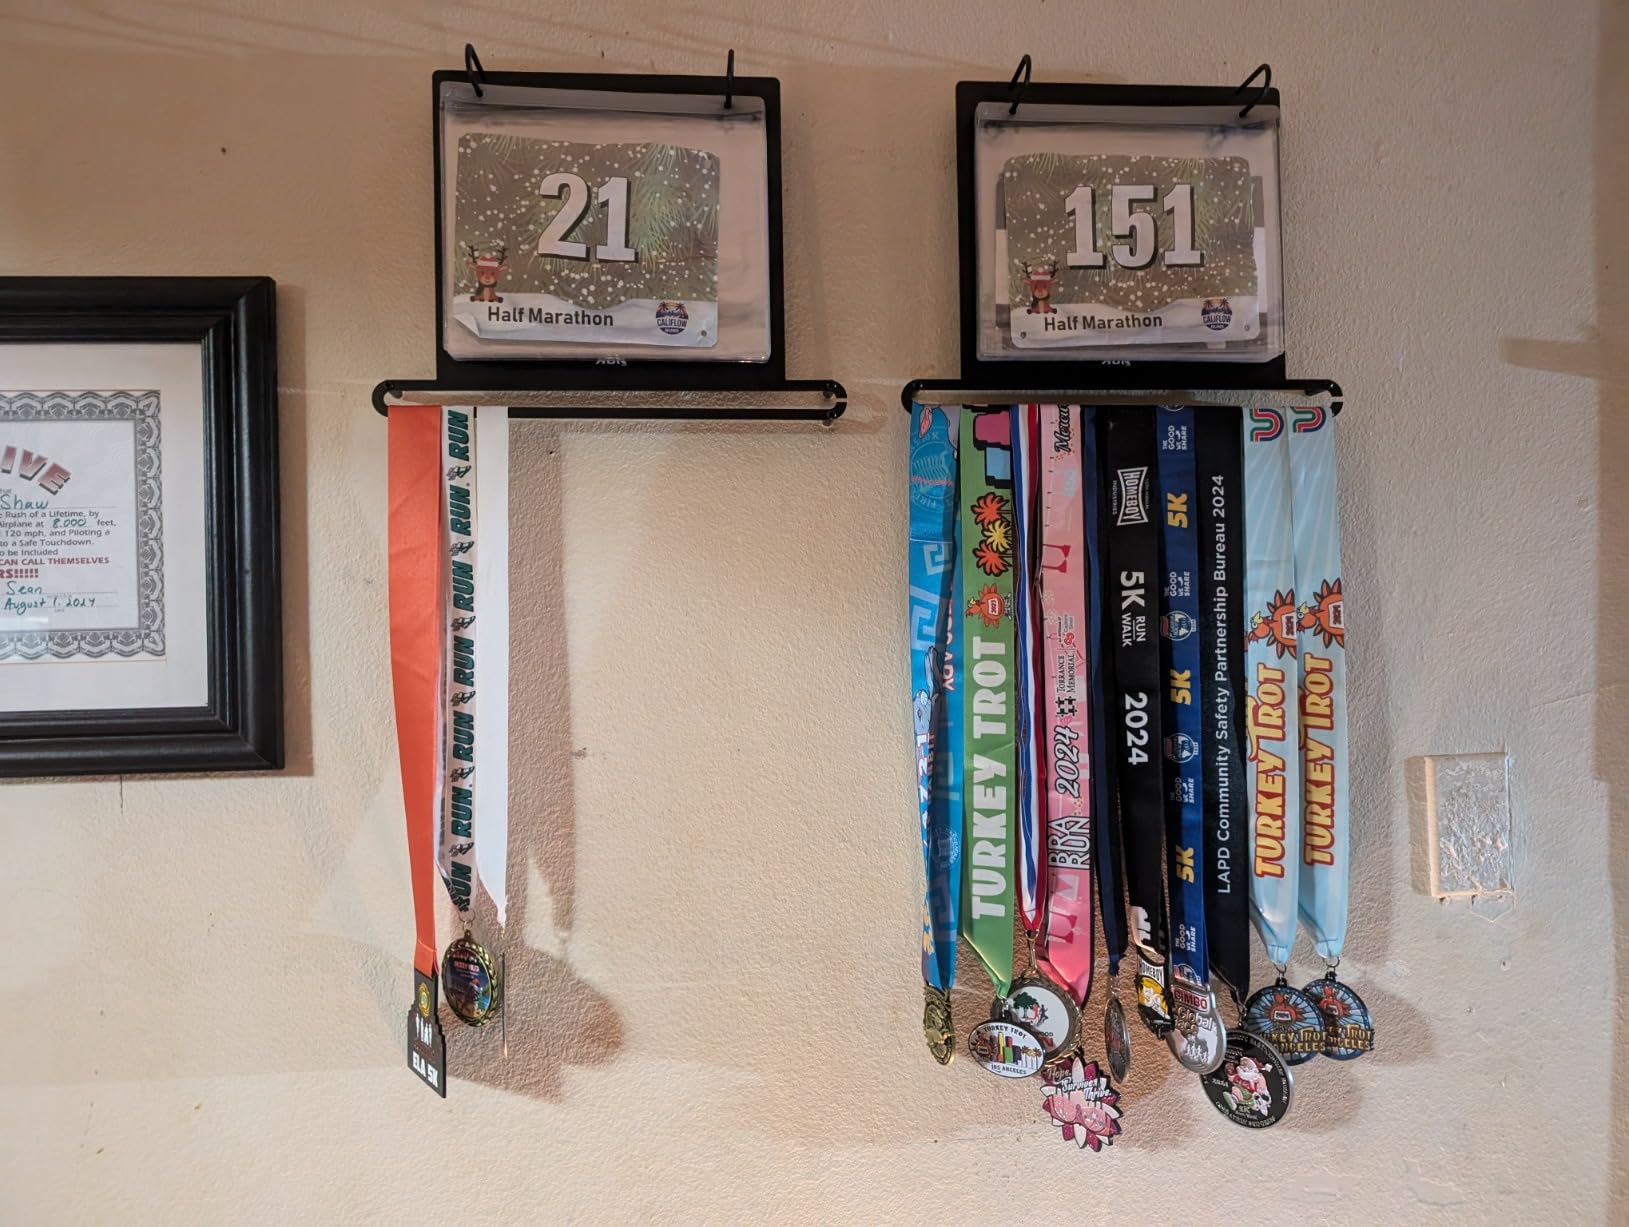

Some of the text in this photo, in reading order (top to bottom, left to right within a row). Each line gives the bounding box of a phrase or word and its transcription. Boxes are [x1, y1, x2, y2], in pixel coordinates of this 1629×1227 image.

[538, 172, 637, 261] 21
[1064, 184, 1203, 268] 151
[488, 306, 614, 326] Half Marathon
[657, 319, 688, 328] CALIFLOW
[1044, 314, 1163, 331] Half Marathon
[1203, 315, 1231, 324] CALIFLOW
[448, 409, 470, 462] RUN
[1167, 425, 1175, 450] GOOD
[0, 493, 48, 510] Shaw
[449, 484, 472, 536] RUN
[1122, 471, 1142, 520] HOMEBOY
[1167, 492, 1188, 529] 5K
[89, 510, 99, 519] by
[40, 538, 95, 547] Touchdown.
[69, 529, 102, 538] Piloting
[21, 558, 45, 566] CALL
[48, 557, 110, 565] THEMSELVES
[6, 580, 42, 596] Sean
[452, 559, 474, 612] RUN
[1120, 571, 1146, 609] 5K
[1169, 571, 1177, 597] GOOD
[1183, 571, 1191, 597] SHARE
[4, 597, 46, 616] August
[66, 597, 96, 608] 2024
[1121, 613, 1133, 648] WALK
[1135, 615, 1147, 642] RUN
[453, 634, 474, 687] RUN
[1056, 655, 1065, 693] TORRANCE
[1066, 654, 1076, 693] MEMORIAL
[1170, 669, 1192, 706] 5K
[1212, 474, 1231, 894] LAPD Community Safety Partnership Bureau 2024
[452, 710, 474, 762] RUN
[1124, 692, 1149, 766] 2024
[1054, 725, 1079, 798] 2024
[1248, 663, 1286, 878] TURKEY TROT
[1302, 653, 1335, 866] TURKEY TROT
[971, 636, 1007, 920] TURKEY TROT
[1174, 777, 1182, 802] GOOD
[1187, 777, 1195, 804] SHARE
[451, 785, 473, 838] RUN
[1048, 816, 1067, 868] BRA
[1066, 816, 1091, 870] RUN
[1174, 845, 1195, 884] 5K
[1174, 989, 1207, 1009] BIMBO
[983, 1025, 1027, 1039] TURKEY TROT
[1178, 1006, 1213, 1030] Global
[1300, 1027, 1327, 1042] TROT
[427, 1062, 438, 1089] 5K
[1002, 1066, 1027, 1075] ANGELES
